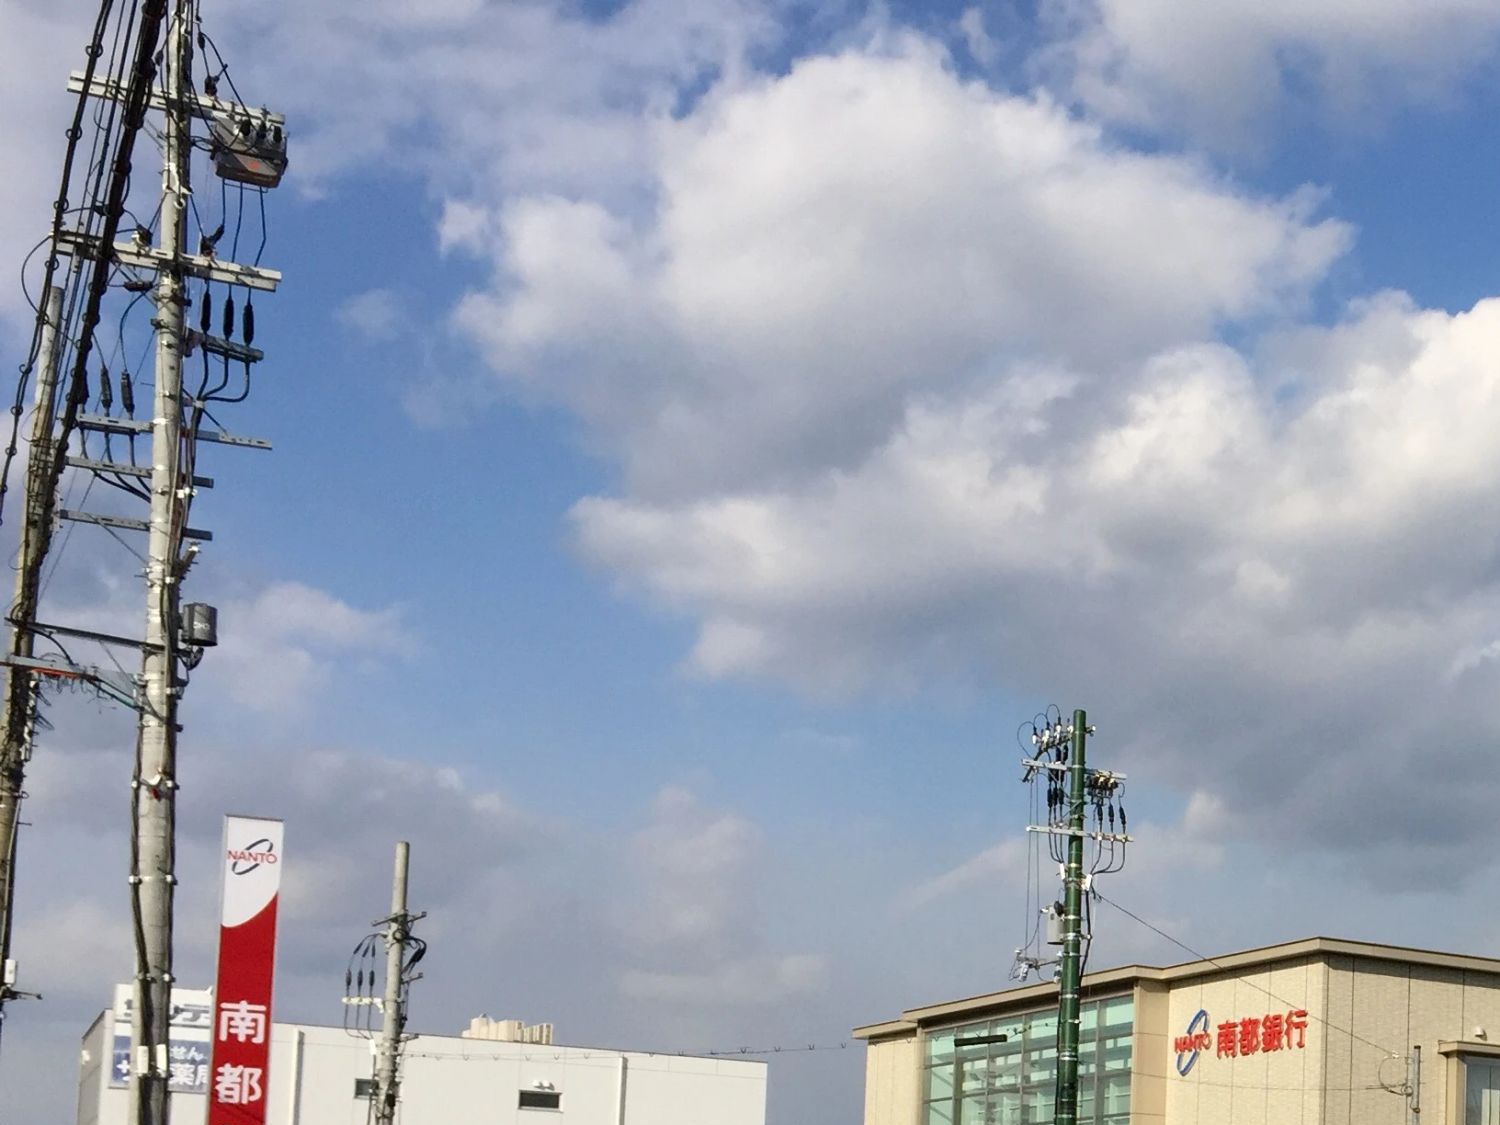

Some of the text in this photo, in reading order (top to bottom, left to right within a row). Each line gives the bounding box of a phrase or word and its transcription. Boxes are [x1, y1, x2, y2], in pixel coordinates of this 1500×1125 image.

[227, 849, 277, 865] NANTO
[1216, 1009, 1309, 1060] 南都銀行
